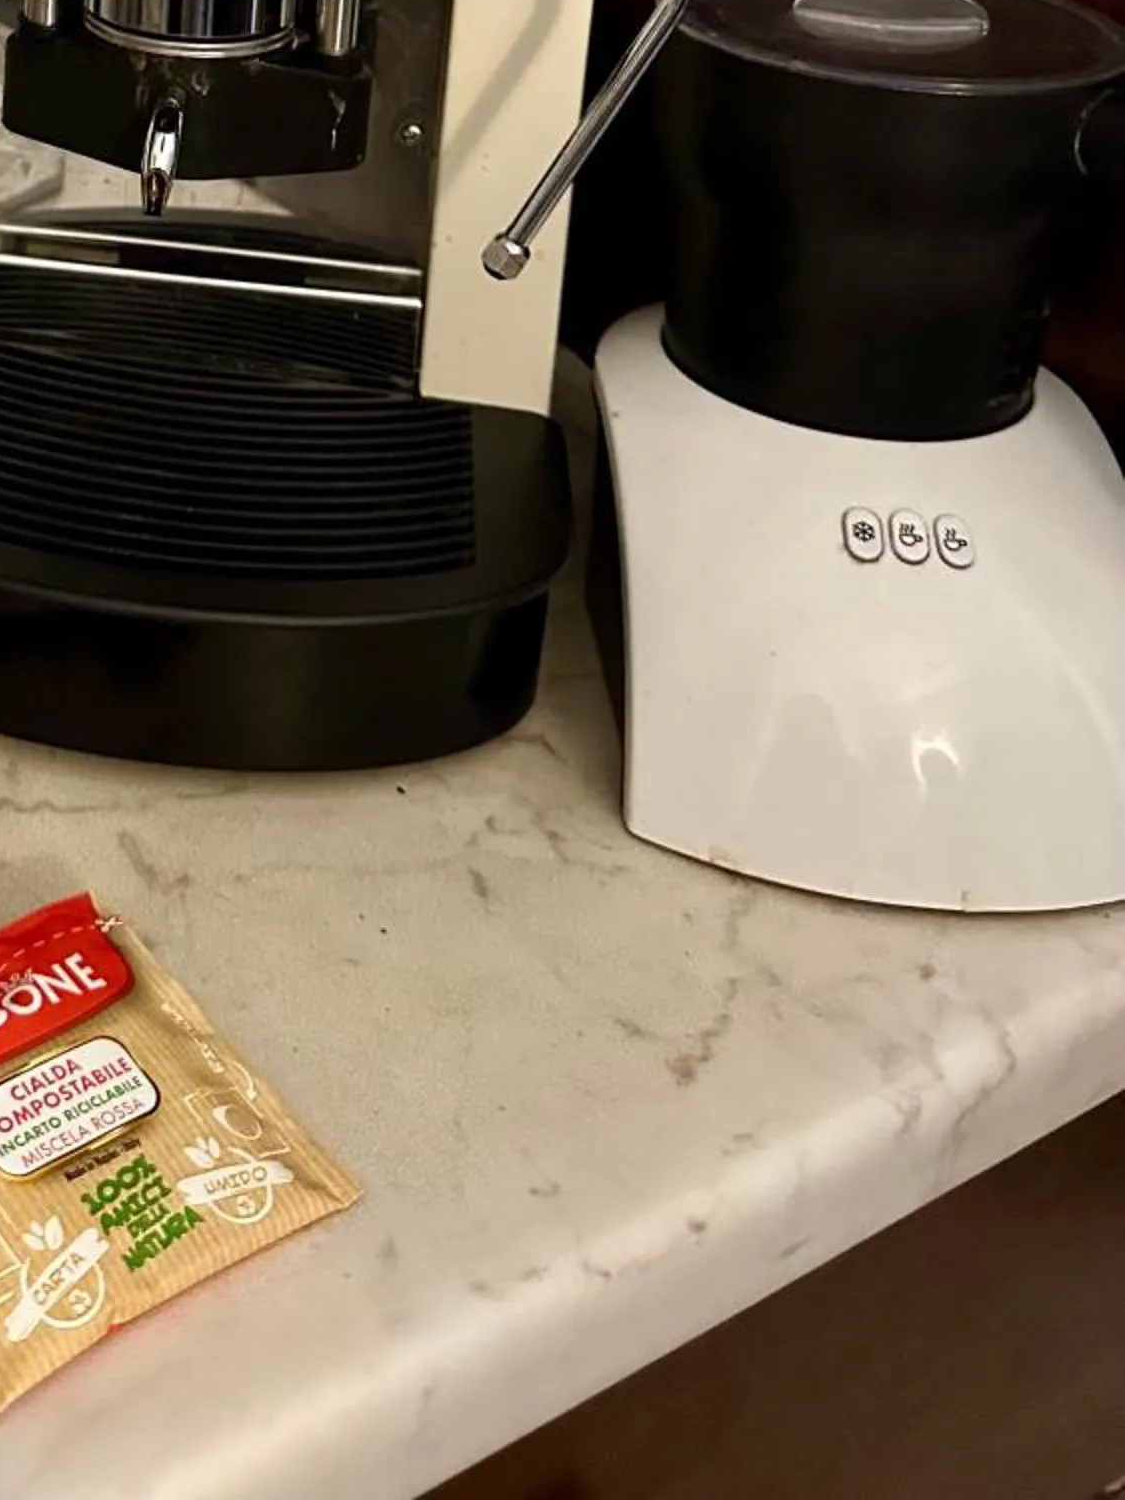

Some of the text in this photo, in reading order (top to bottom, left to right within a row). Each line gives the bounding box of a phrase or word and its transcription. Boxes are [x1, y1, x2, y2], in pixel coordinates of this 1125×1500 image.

[10, 1058, 83, 1102] CIALDA
[63, 1075, 144, 1122] RICICLABILE
[20, 1124, 92, 1168] MISCELA
[91, 1098, 145, 1131] ROSSA
[80, 1152, 157, 1216] 100%
[203, 1165, 268, 1195] UMIDO
[32, 1250, 86, 1306] CARTA
